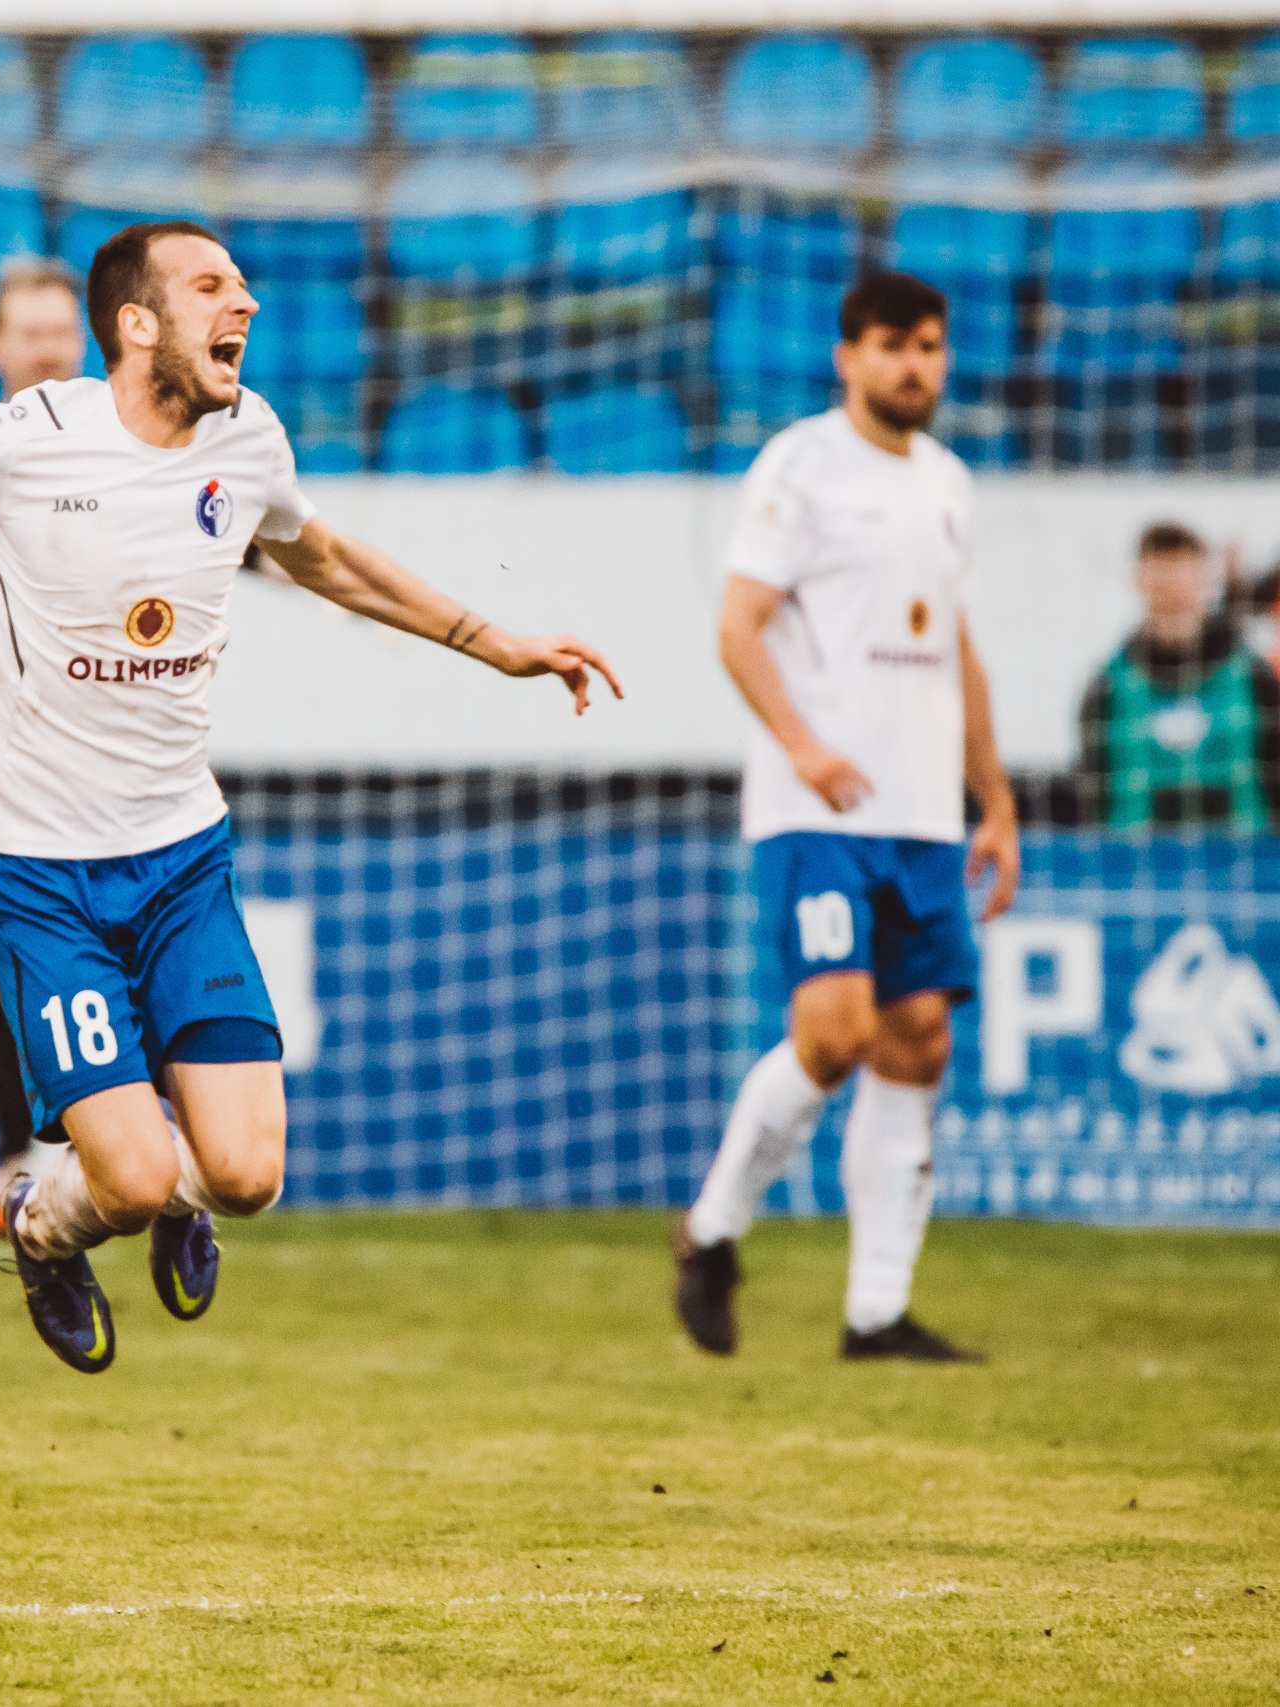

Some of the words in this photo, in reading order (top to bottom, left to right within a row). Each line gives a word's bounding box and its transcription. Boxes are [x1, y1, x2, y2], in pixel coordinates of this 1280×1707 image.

[52, 498, 99, 513] JAKO
[796, 891, 854, 962] 10
[204, 972, 246, 992] JAKO
[40, 989, 119, 1072] 18
